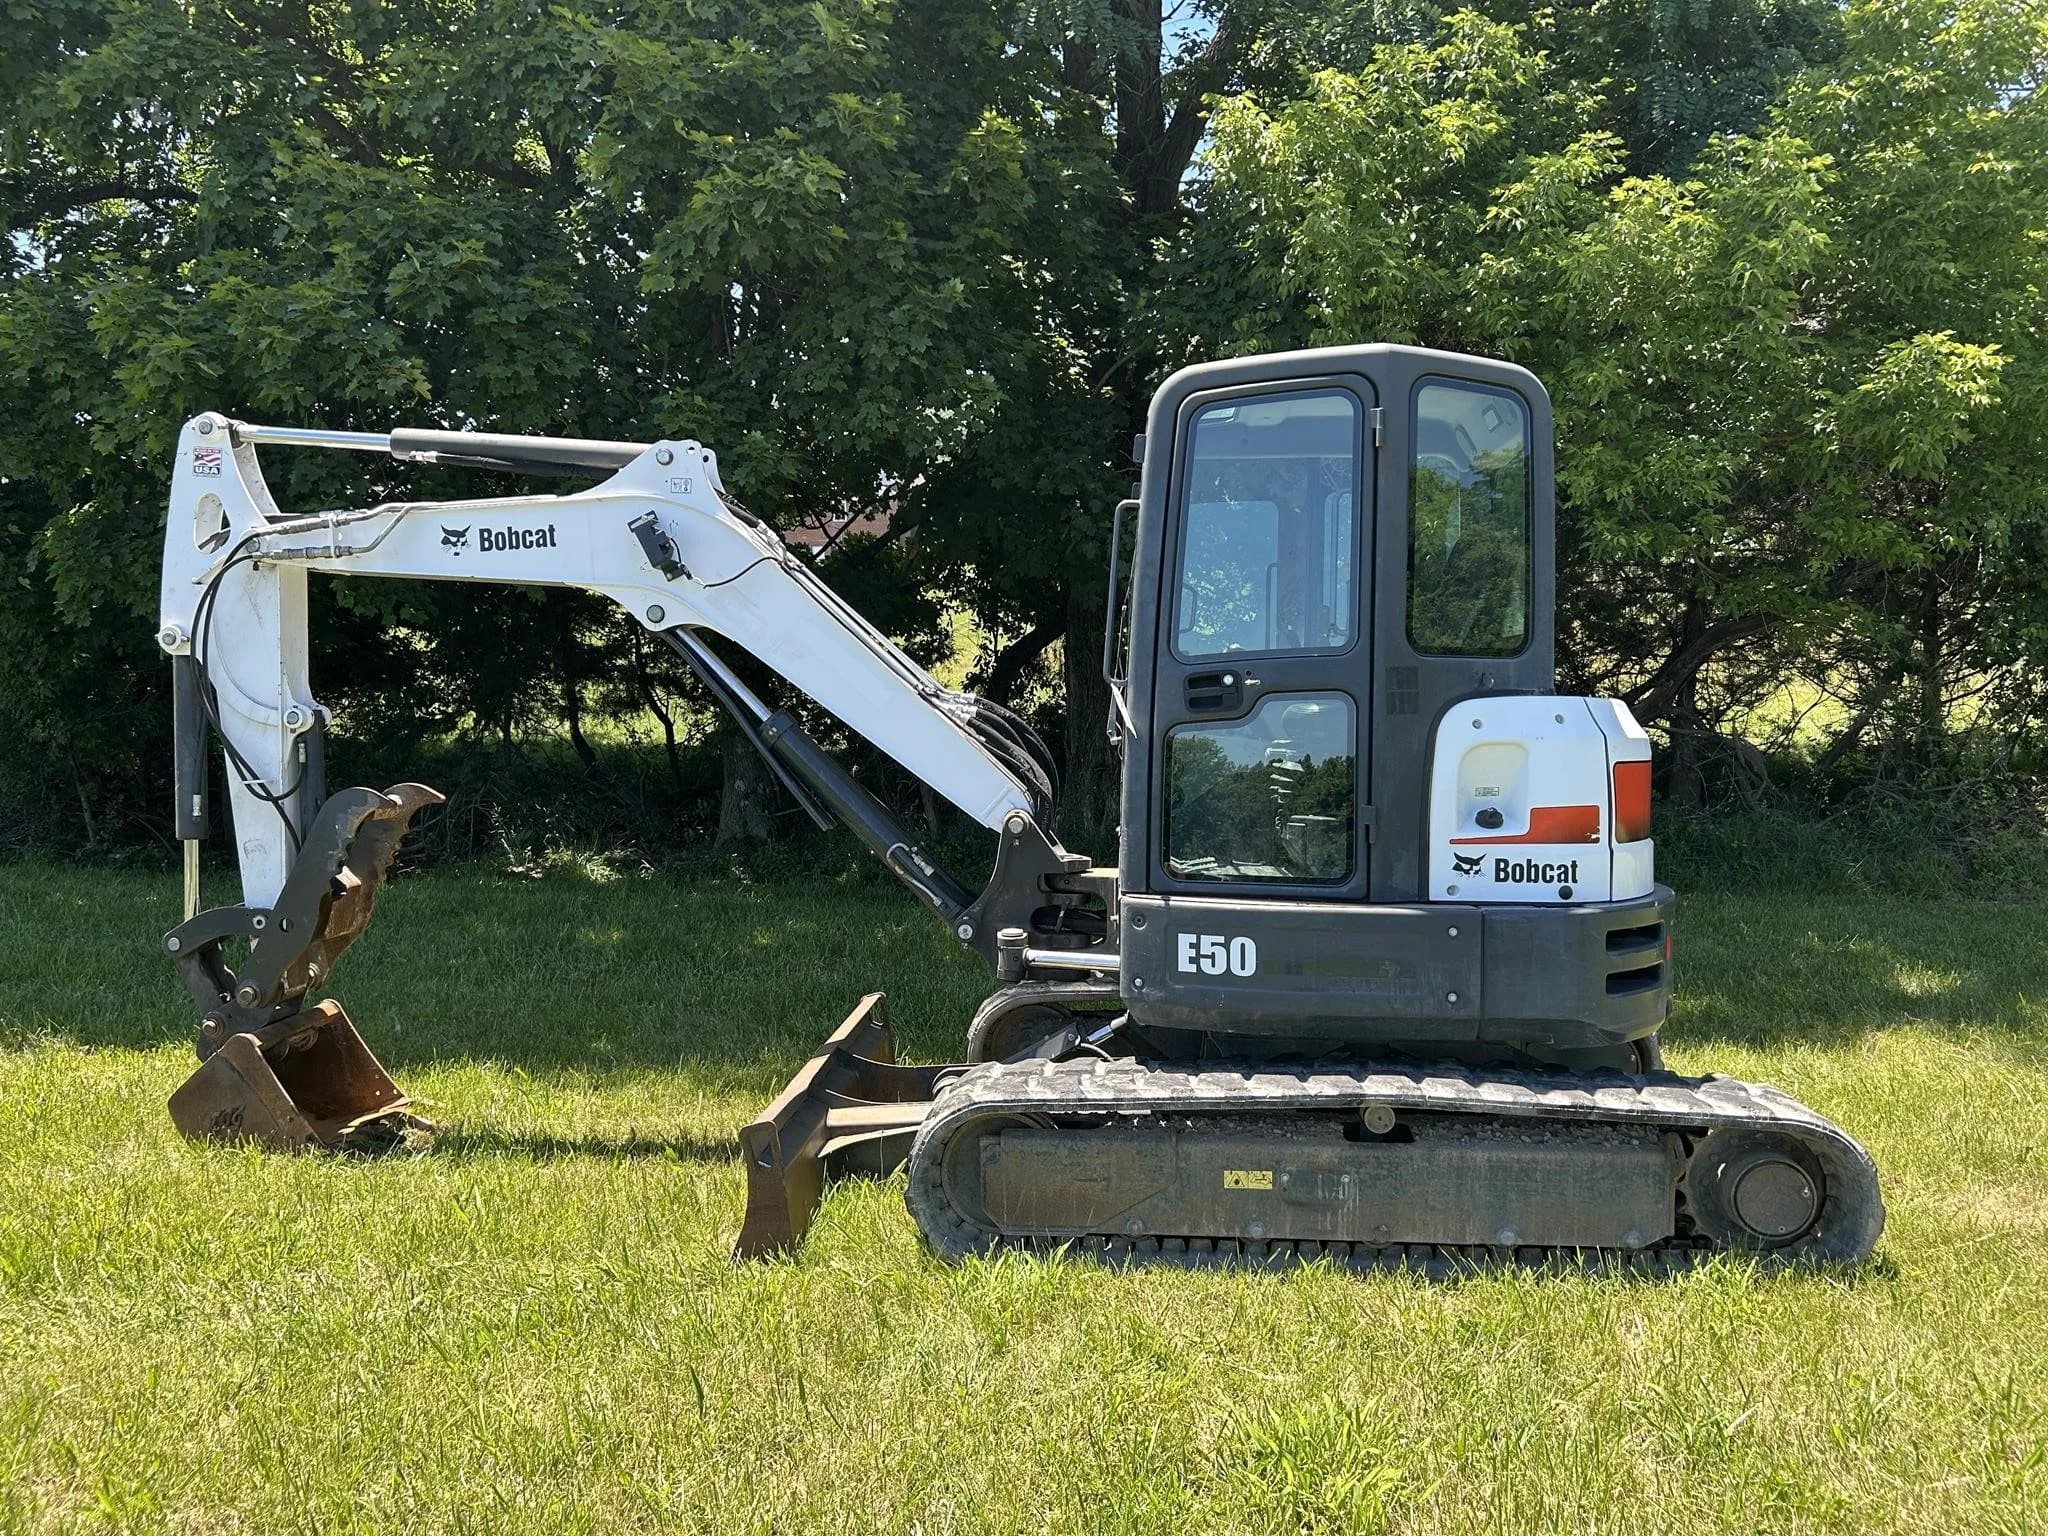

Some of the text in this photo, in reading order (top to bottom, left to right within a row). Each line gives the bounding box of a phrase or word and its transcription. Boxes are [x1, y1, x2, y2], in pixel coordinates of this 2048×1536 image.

[195, 466, 218, 474] USA
[479, 524, 557, 552] Bobcat
[1494, 858, 1578, 884] Bobcat
[1178, 933, 1257, 977] E50
